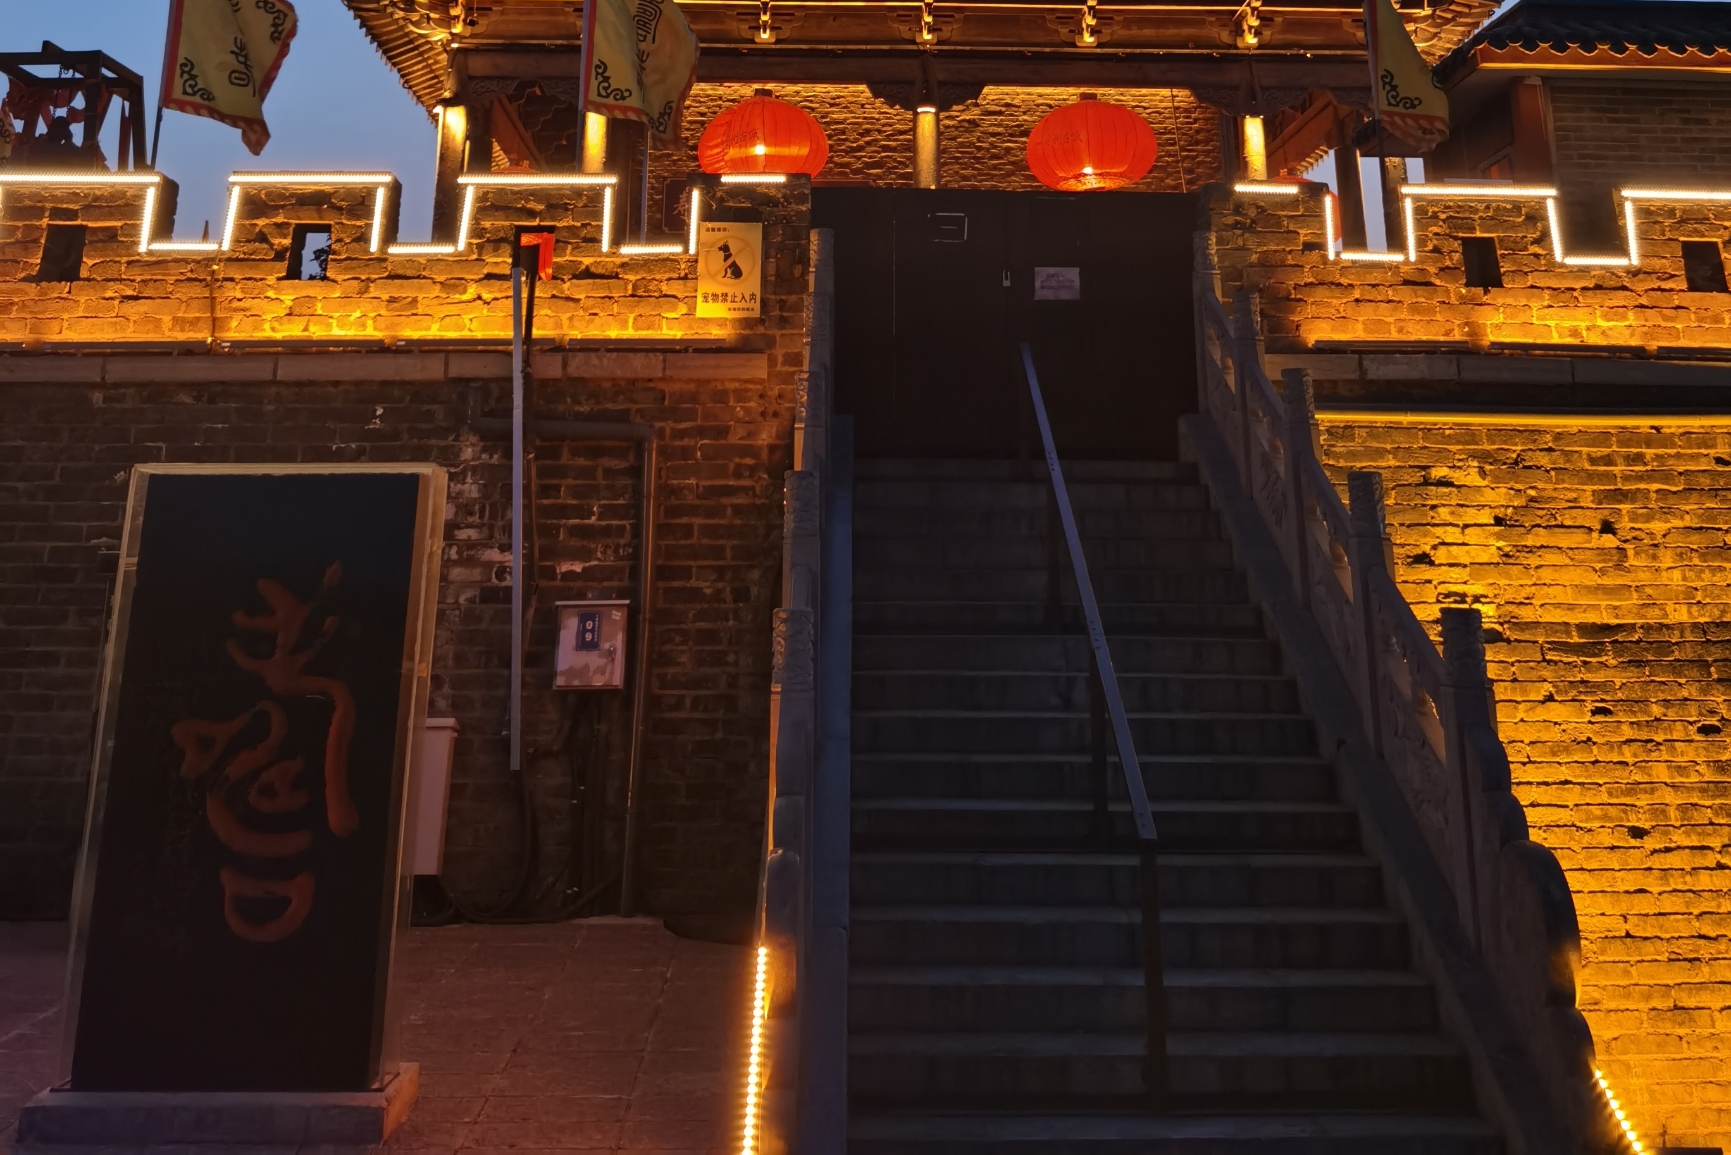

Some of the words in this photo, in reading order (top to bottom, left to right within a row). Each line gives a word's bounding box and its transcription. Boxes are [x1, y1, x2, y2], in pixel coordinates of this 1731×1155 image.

[701, 291, 757, 304] 宠物禁止入内
[585, 620, 593, 641] 09
